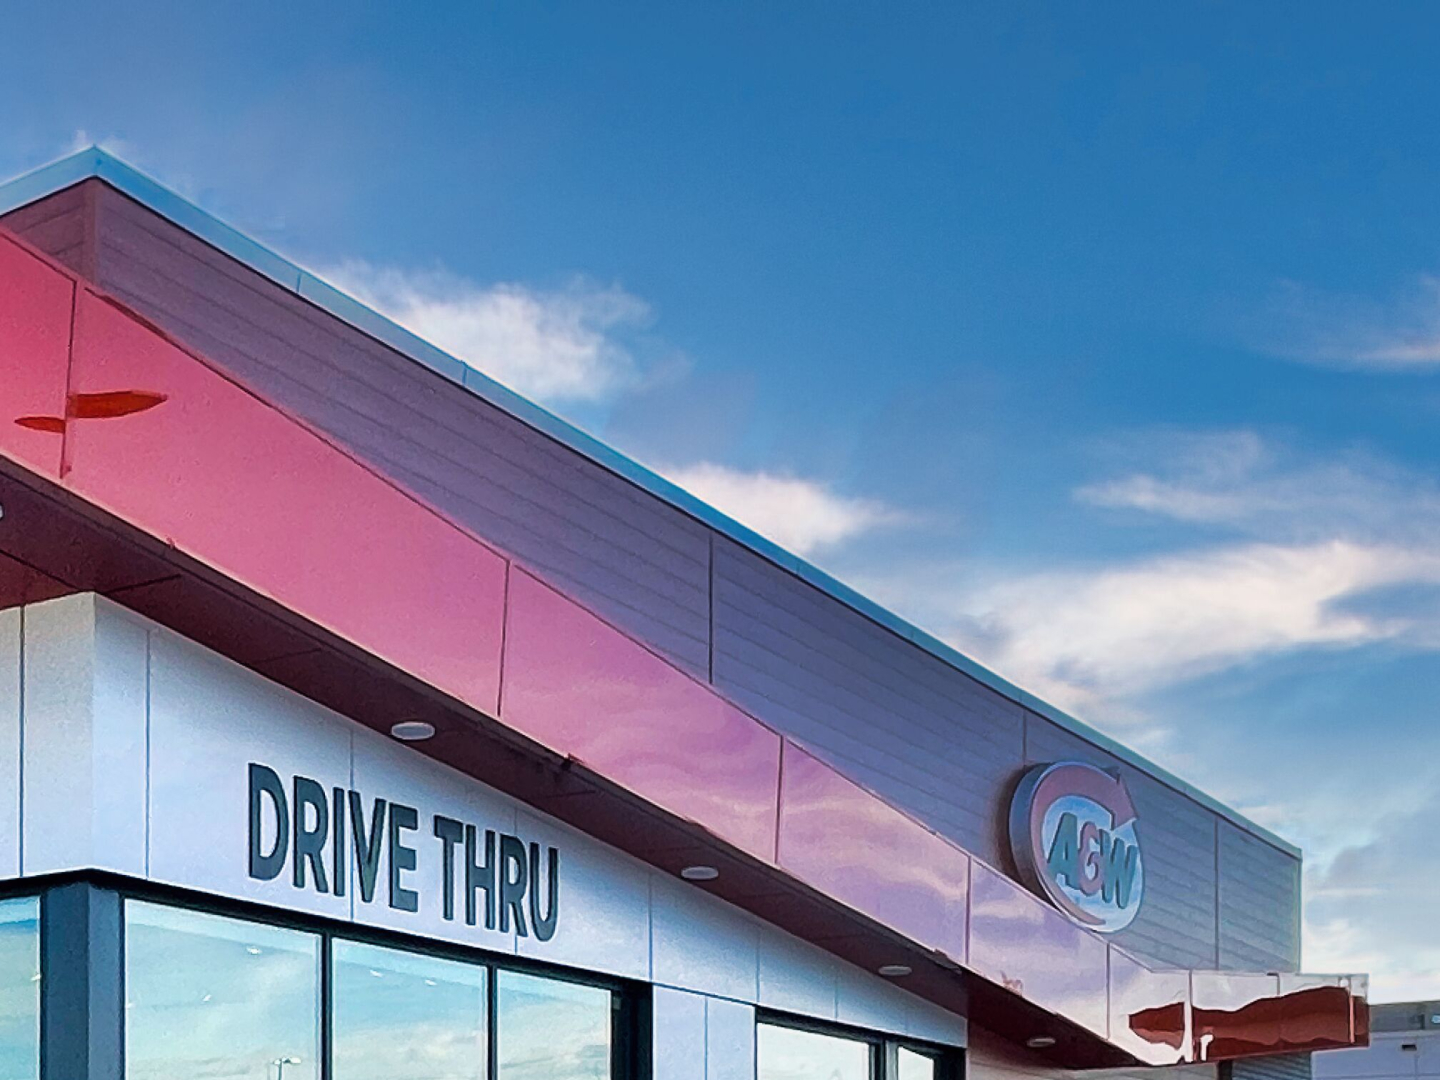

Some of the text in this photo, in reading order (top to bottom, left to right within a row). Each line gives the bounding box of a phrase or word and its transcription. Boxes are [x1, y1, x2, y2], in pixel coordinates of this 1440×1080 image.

[248, 762, 559, 942] DRIVE THRU
[1047, 811, 1139, 910] A&W
